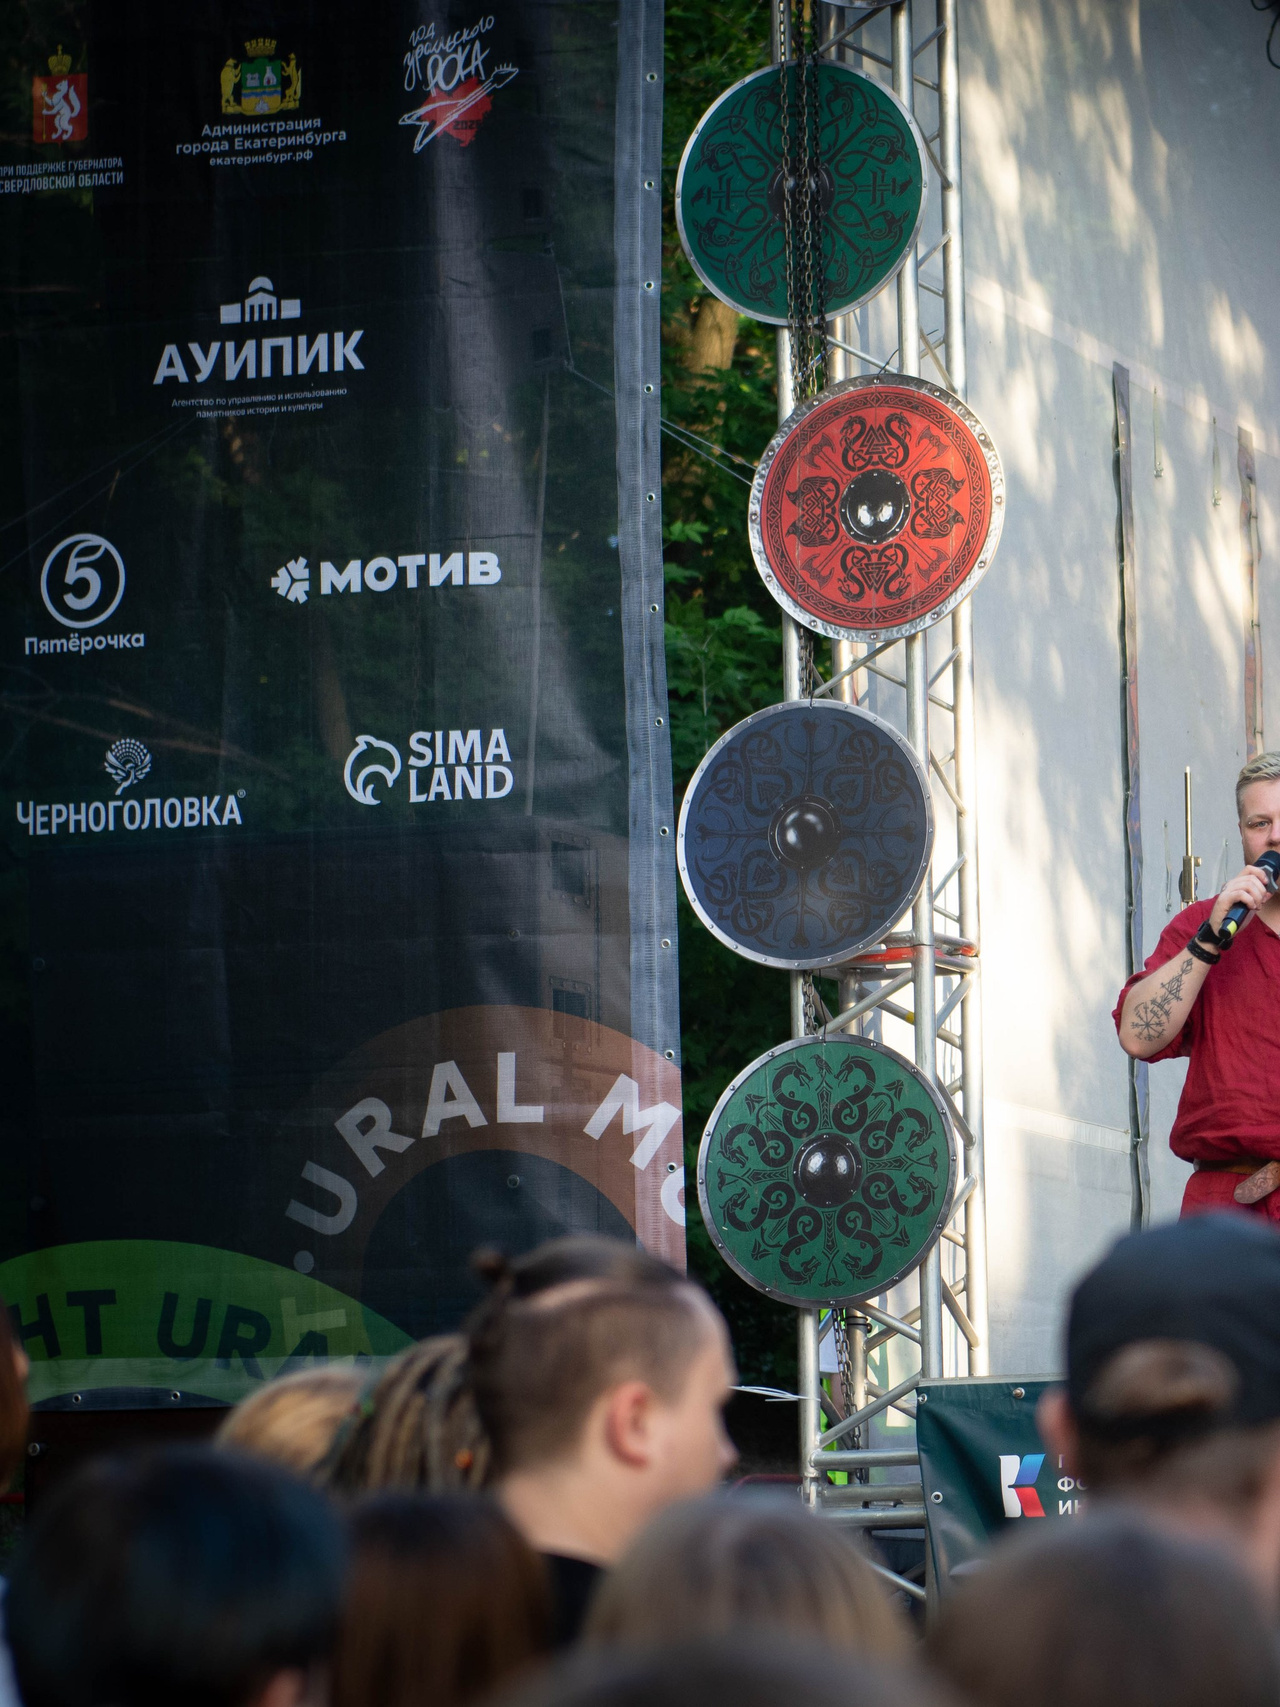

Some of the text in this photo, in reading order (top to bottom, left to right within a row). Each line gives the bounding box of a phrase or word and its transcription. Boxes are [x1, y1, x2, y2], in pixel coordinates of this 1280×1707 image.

[201, 118, 321, 137] Администрация
[176, 130, 347, 155] города Екатеринбурга
[16, 161, 66, 176] ПОДДЕРЖКЕ
[68, 157, 123, 171] ГУБЕРНАТОРА
[209, 149, 313, 166] екатеринбург.рф
[0, 171, 124, 194] СВЕРДЛОВСКОЙ ОБЛАСТИ
[153, 330, 365, 385] АУИПИК
[320, 552, 501, 595] МОТИВ
[24, 631, 145, 655] Пятёрочка
[408, 729, 512, 767] SIMA
[408, 763, 514, 803] LAND
[285, 1052, 544, 1236] URAL
